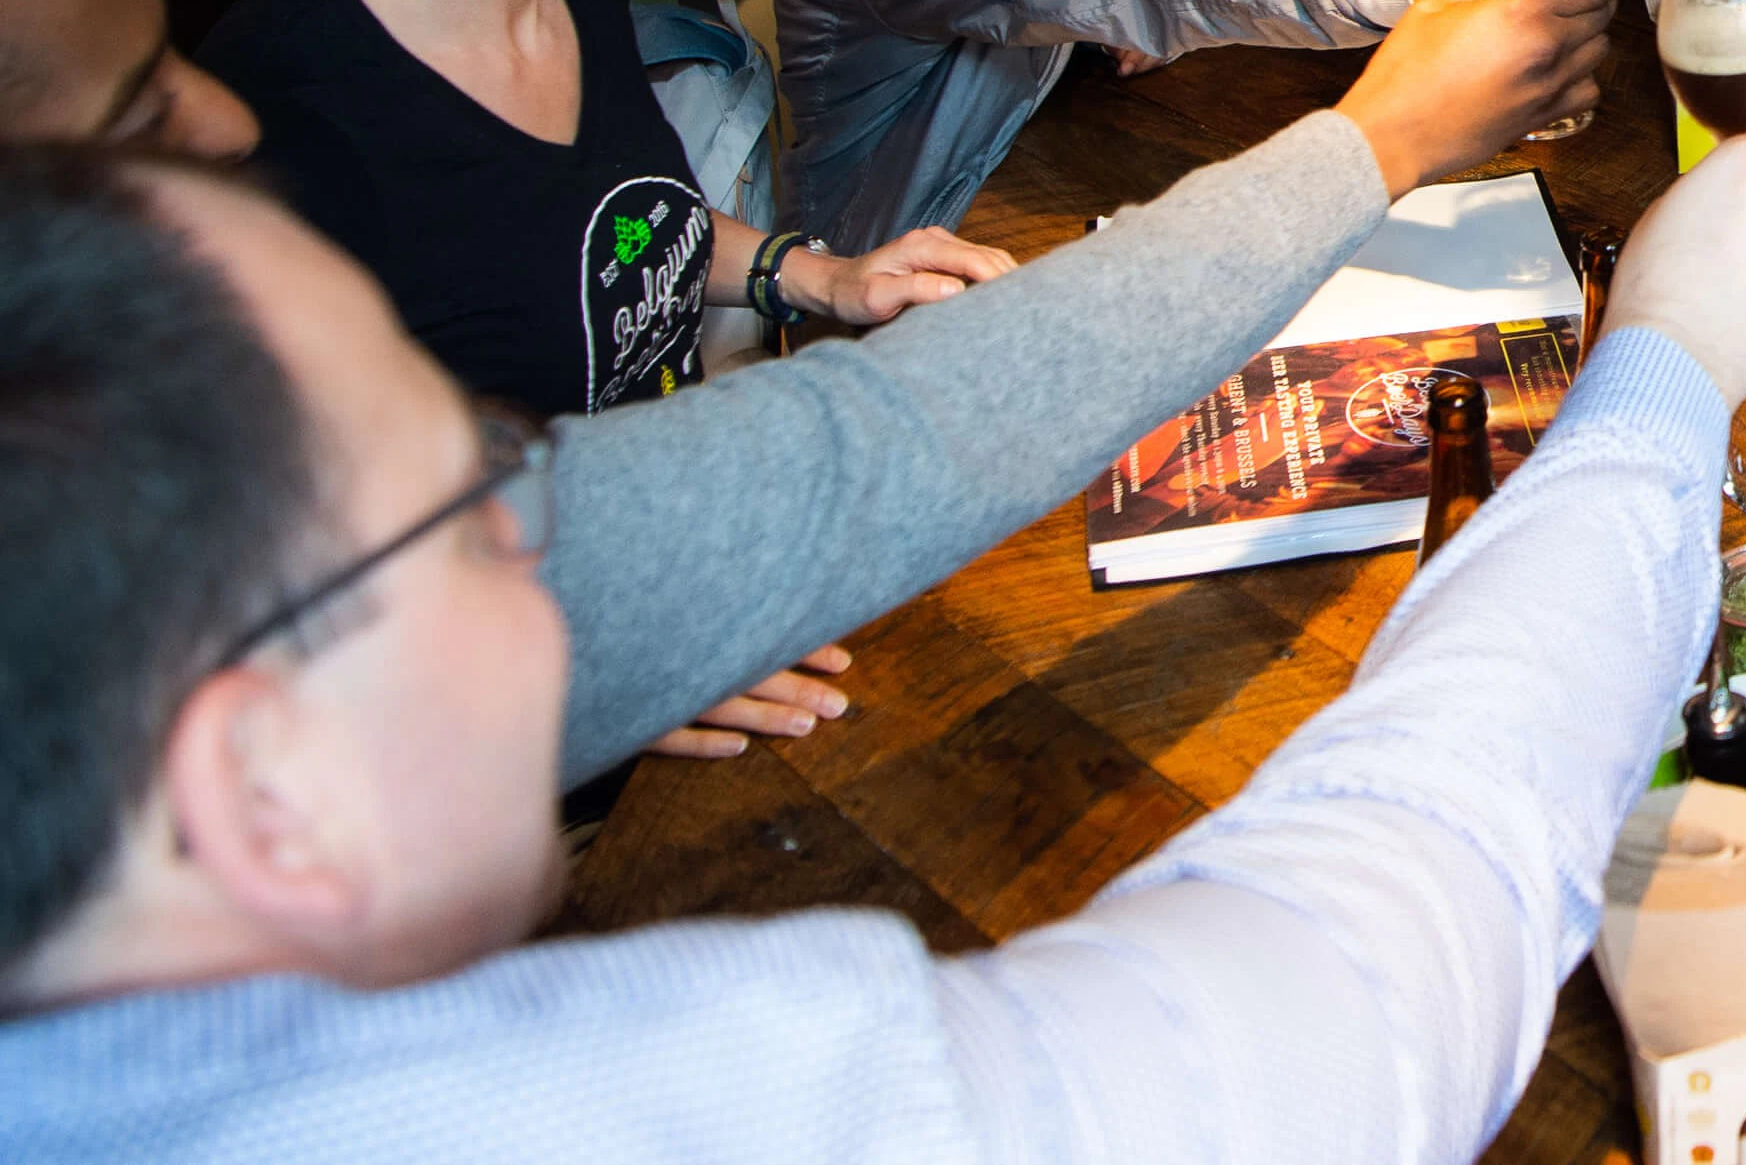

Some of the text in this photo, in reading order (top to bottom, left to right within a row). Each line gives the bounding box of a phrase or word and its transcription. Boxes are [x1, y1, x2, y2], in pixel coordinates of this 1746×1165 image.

[613, 206, 710, 369] Belgium
[1228, 374, 1257, 489] GHENT & BRUSSELS
[1274, 378, 1295, 428] TASTING
[1297, 380, 1326, 465] YOUR PRIVATE
[1282, 430, 1307, 500] EXPERIENCE
